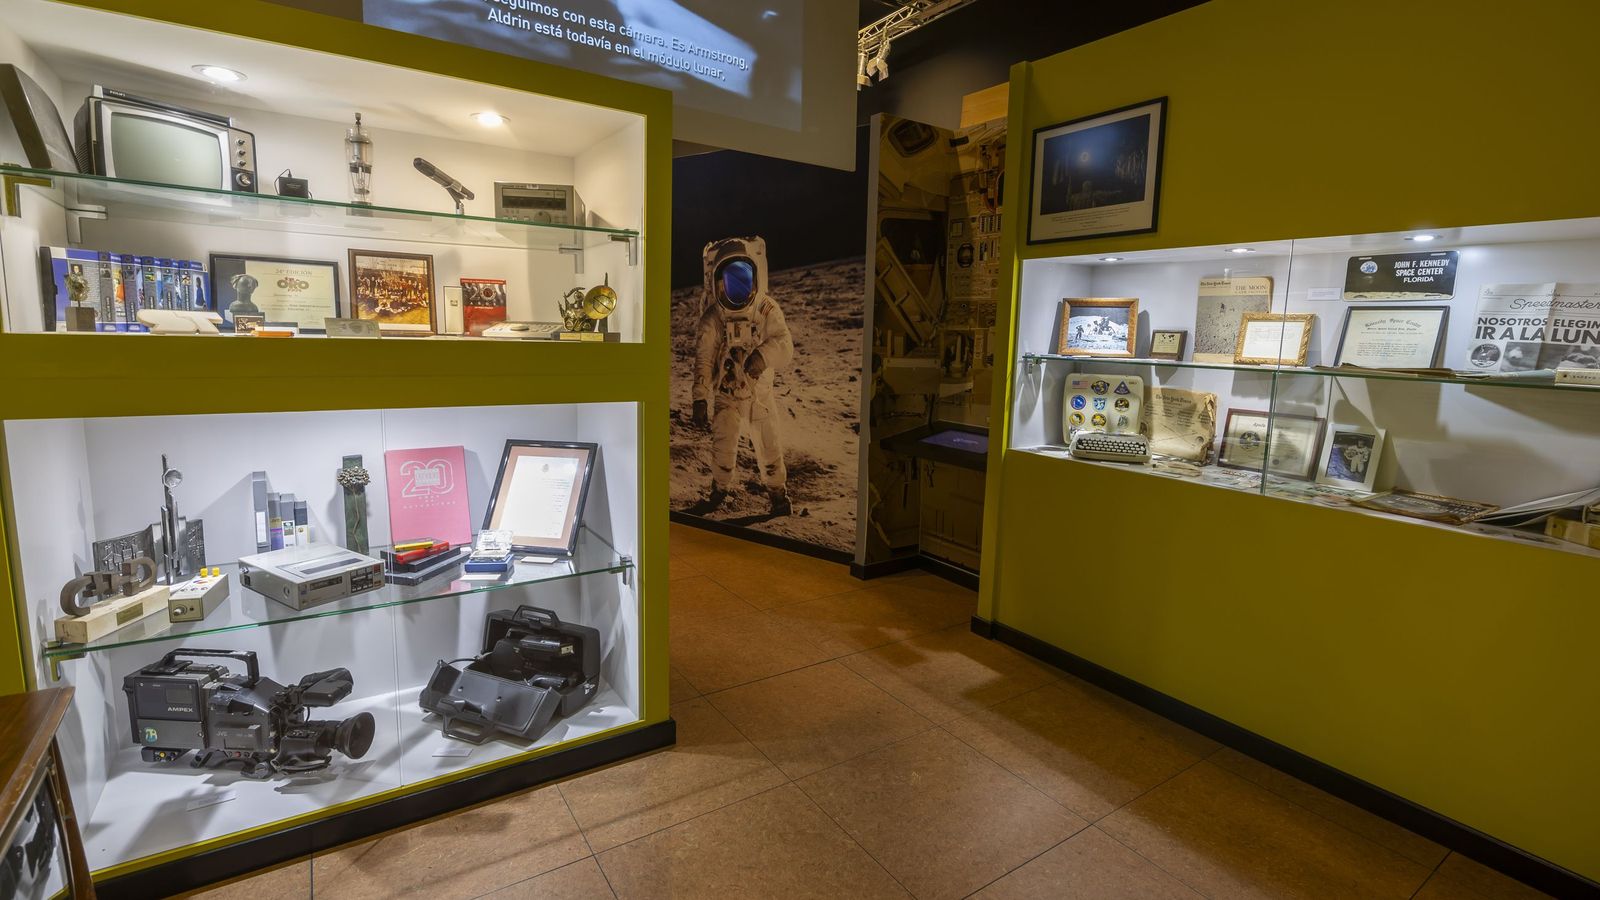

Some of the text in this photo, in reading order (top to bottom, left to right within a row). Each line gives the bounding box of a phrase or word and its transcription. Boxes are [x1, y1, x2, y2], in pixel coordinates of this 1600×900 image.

[493, 0, 559, 18] guimos
[562, 10, 586, 25] con
[589, 18, 616, 33] esta
[619, 24, 668, 48] cámara.
[672, 36, 686, 52] Es
[488, 8, 530, 30] Aldrin
[534, 22, 563, 39] está
[566, 28, 611, 51] todavía
[615, 43, 630, 55] en
[633, 46, 644, 59] el
[648, 51, 690, 71] módulo
[1394, 259, 1450, 269] JOHN F. KENNEDY
[1395, 267, 1444, 277] SPACE CENTER
[1509, 297, 1600, 310] Speedmaster
[1477, 317, 1548, 327] NOSOTROS
[1475, 325, 1600, 344] IR A LA LUN
